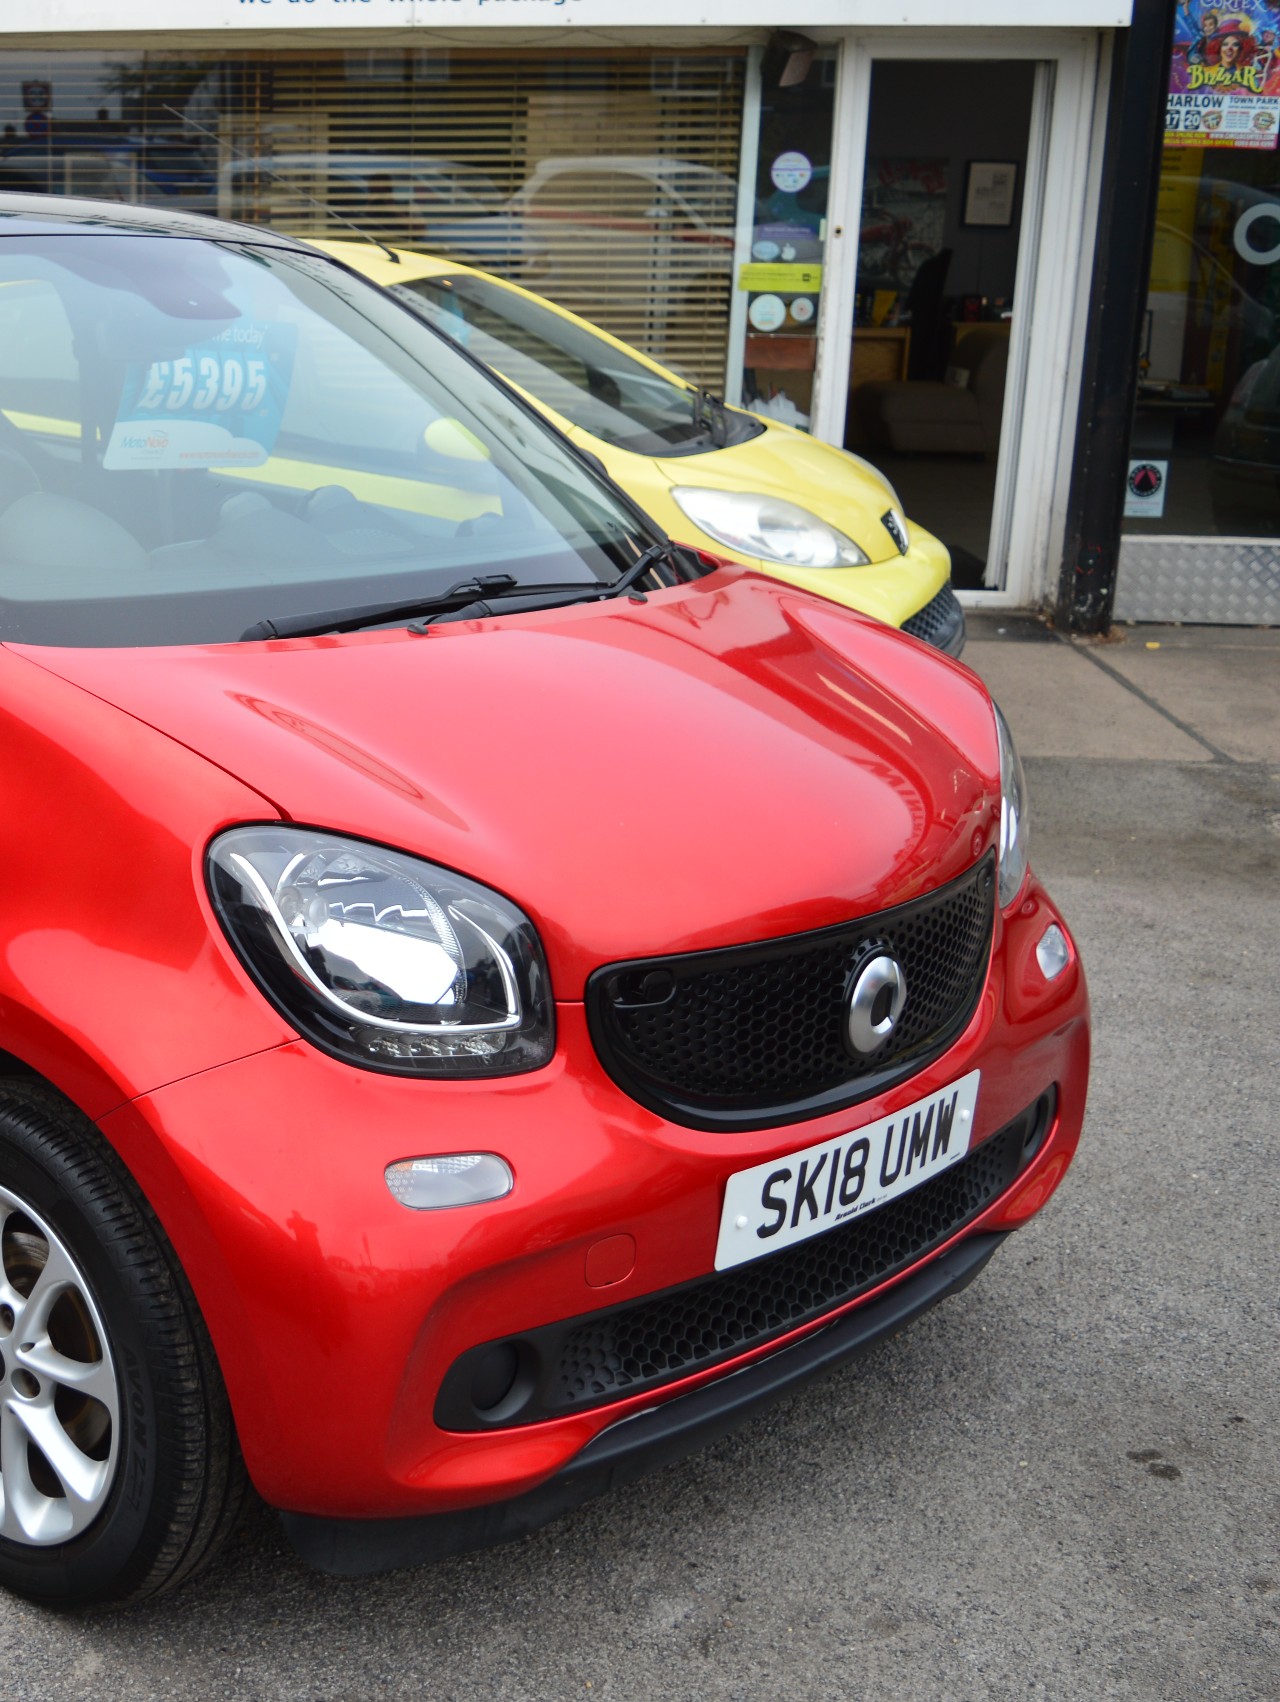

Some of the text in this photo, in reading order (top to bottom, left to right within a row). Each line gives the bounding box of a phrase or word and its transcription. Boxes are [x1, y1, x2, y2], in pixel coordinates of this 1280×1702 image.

[1167, 95, 1224, 108] HARLOW
[1230, 96, 1254, 104] TOWN
[1255, 97, 1279, 105] PARK
[1185, 113, 1200, 126] 20
[136, 357, 267, 411] £5395
[756, 1090, 959, 1239] SK18 UMW
[835, 1206, 859, 1221] Arnold
